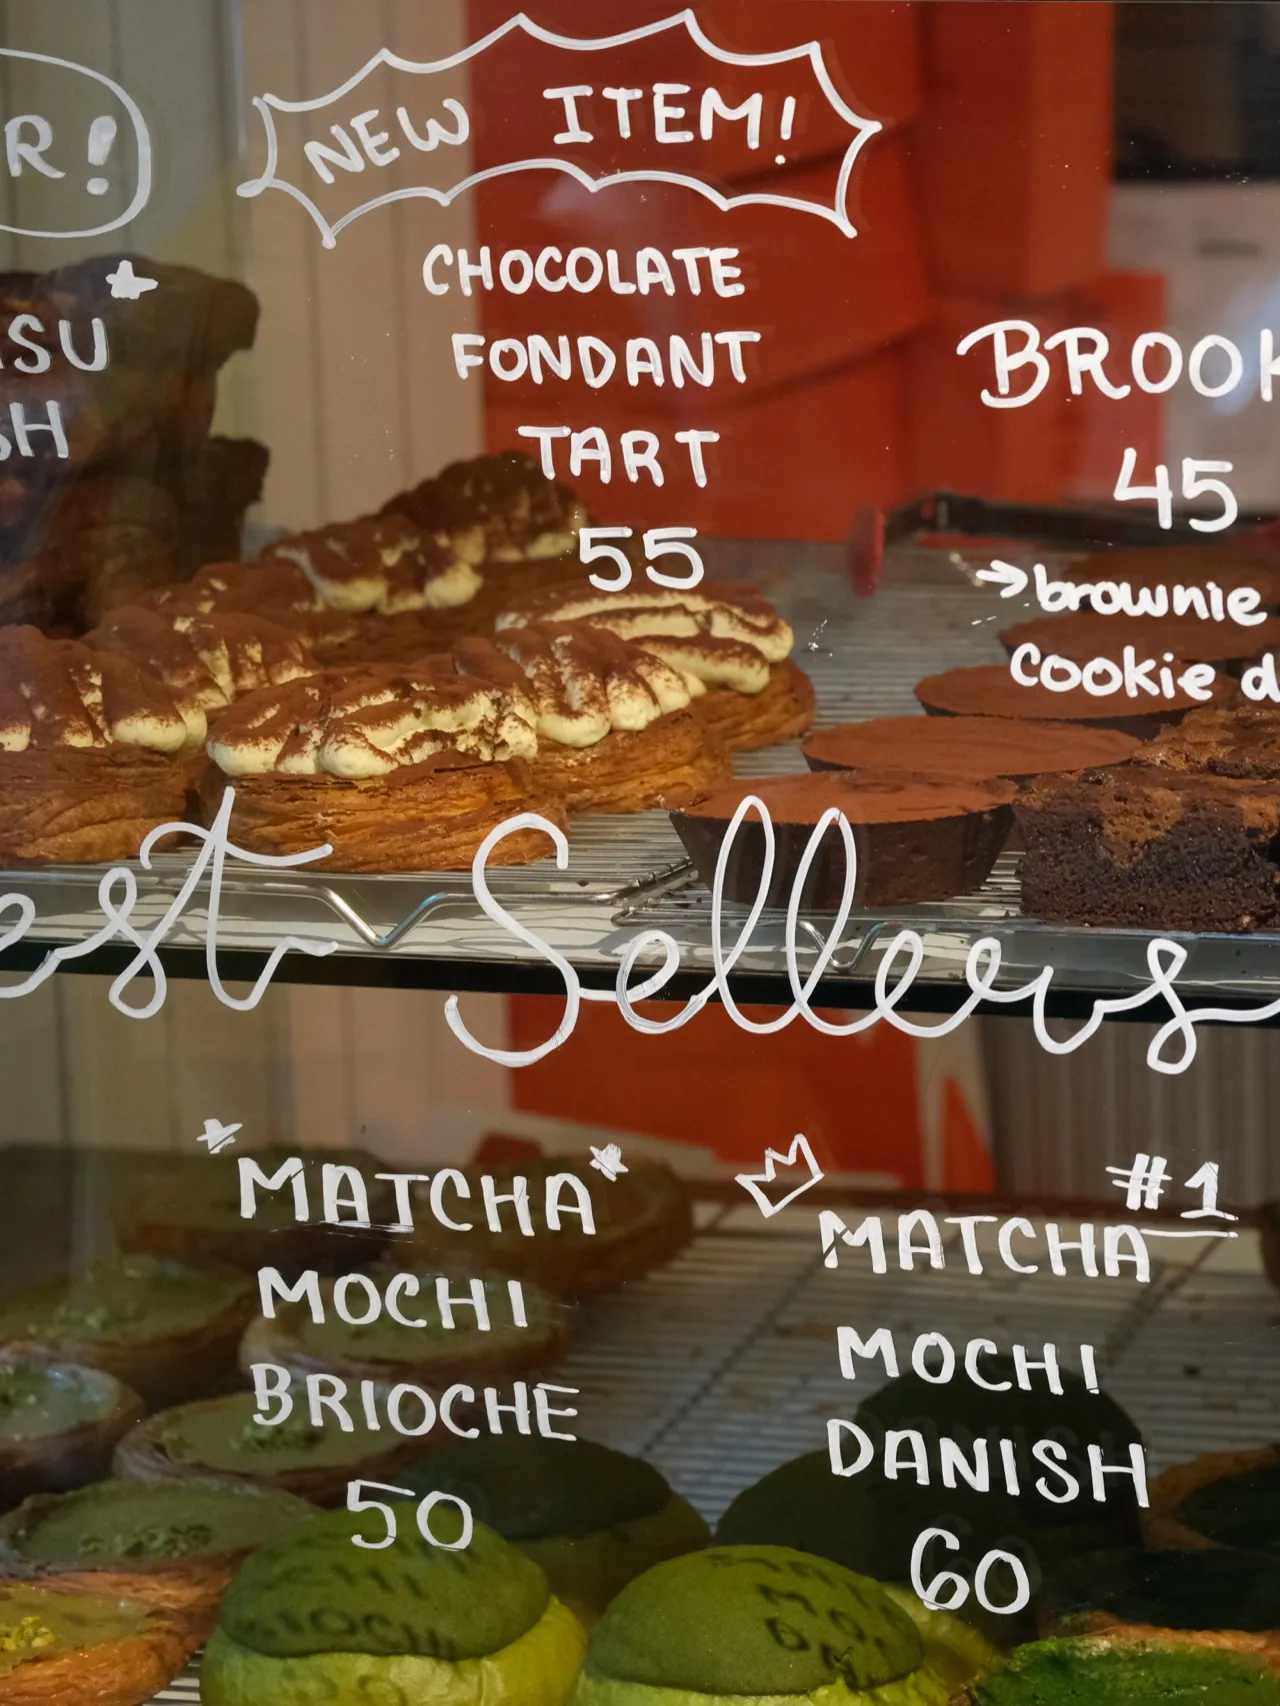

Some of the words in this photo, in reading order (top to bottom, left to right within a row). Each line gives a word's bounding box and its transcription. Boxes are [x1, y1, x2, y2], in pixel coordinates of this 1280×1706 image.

[304, 99, 468, 184] NEW
[543, 83, 797, 166] ITEM!
[423, 244, 745, 296] CHOCOLATE
[452, 331, 761, 387] FONDANT
[518, 427, 720, 488] TART
[1113, 447, 1238, 532] 45
[580, 526, 705, 591] 55
[1033, 564, 1268, 626] brownie
[238, 1156, 597, 1236] MATCHA
[1104, 1153, 1240, 1222] #1
[818, 1209, 1151, 1283] MATCHA
[257, 1266, 529, 1332] MOCHI
[837, 1326, 1101, 1396] MOCHI
[251, 1363, 580, 1442] BRIOCHE
[826, 1419, 1151, 1509] DANISH
[346, 1479, 474, 1551] 50
[910, 1526, 1032, 1616] 60
